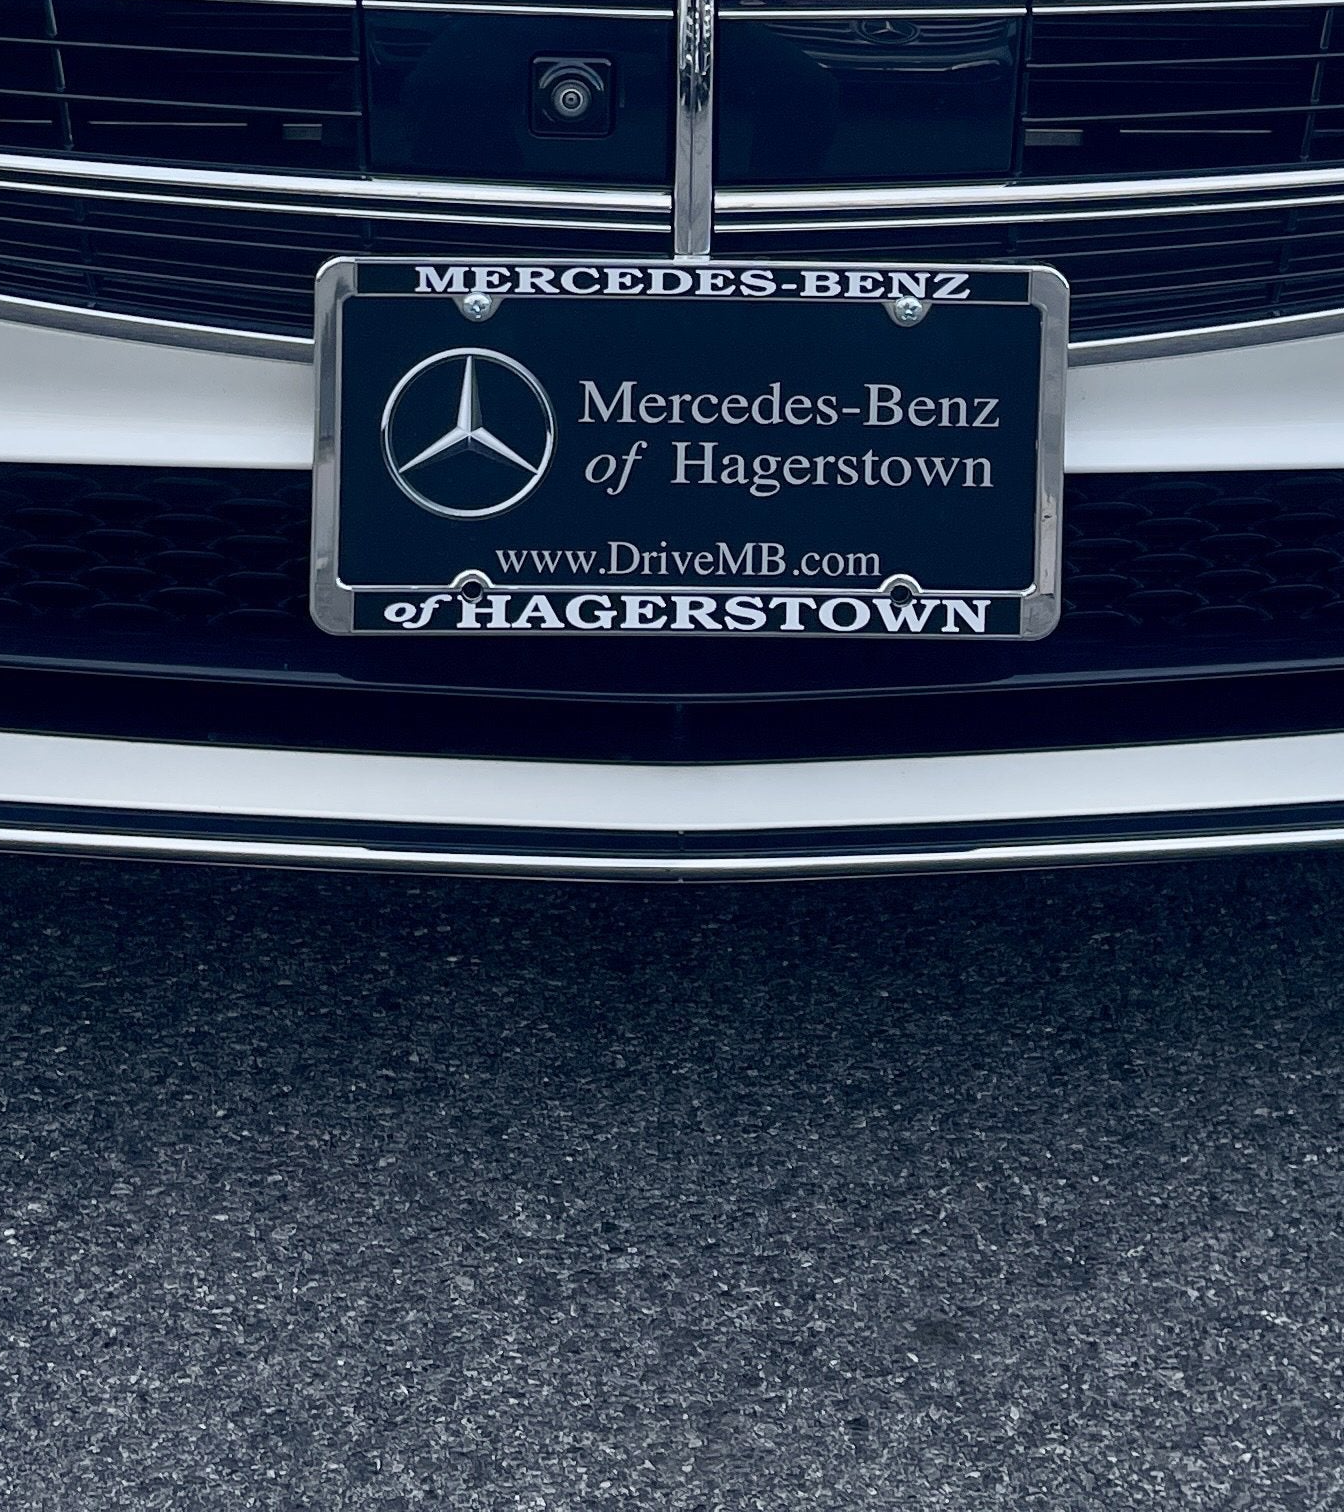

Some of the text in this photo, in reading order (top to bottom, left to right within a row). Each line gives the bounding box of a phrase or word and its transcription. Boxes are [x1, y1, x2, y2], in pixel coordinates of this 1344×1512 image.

[414, 266, 971, 300] MERCEDES-BENZ
[577, 380, 1001, 428] Mercedes-Benz
[584, 440, 995, 497] of Hagerstown
[495, 540, 882, 577] www.DriveMB.com
[383, 593, 992, 633] of HAGERSTOWN
